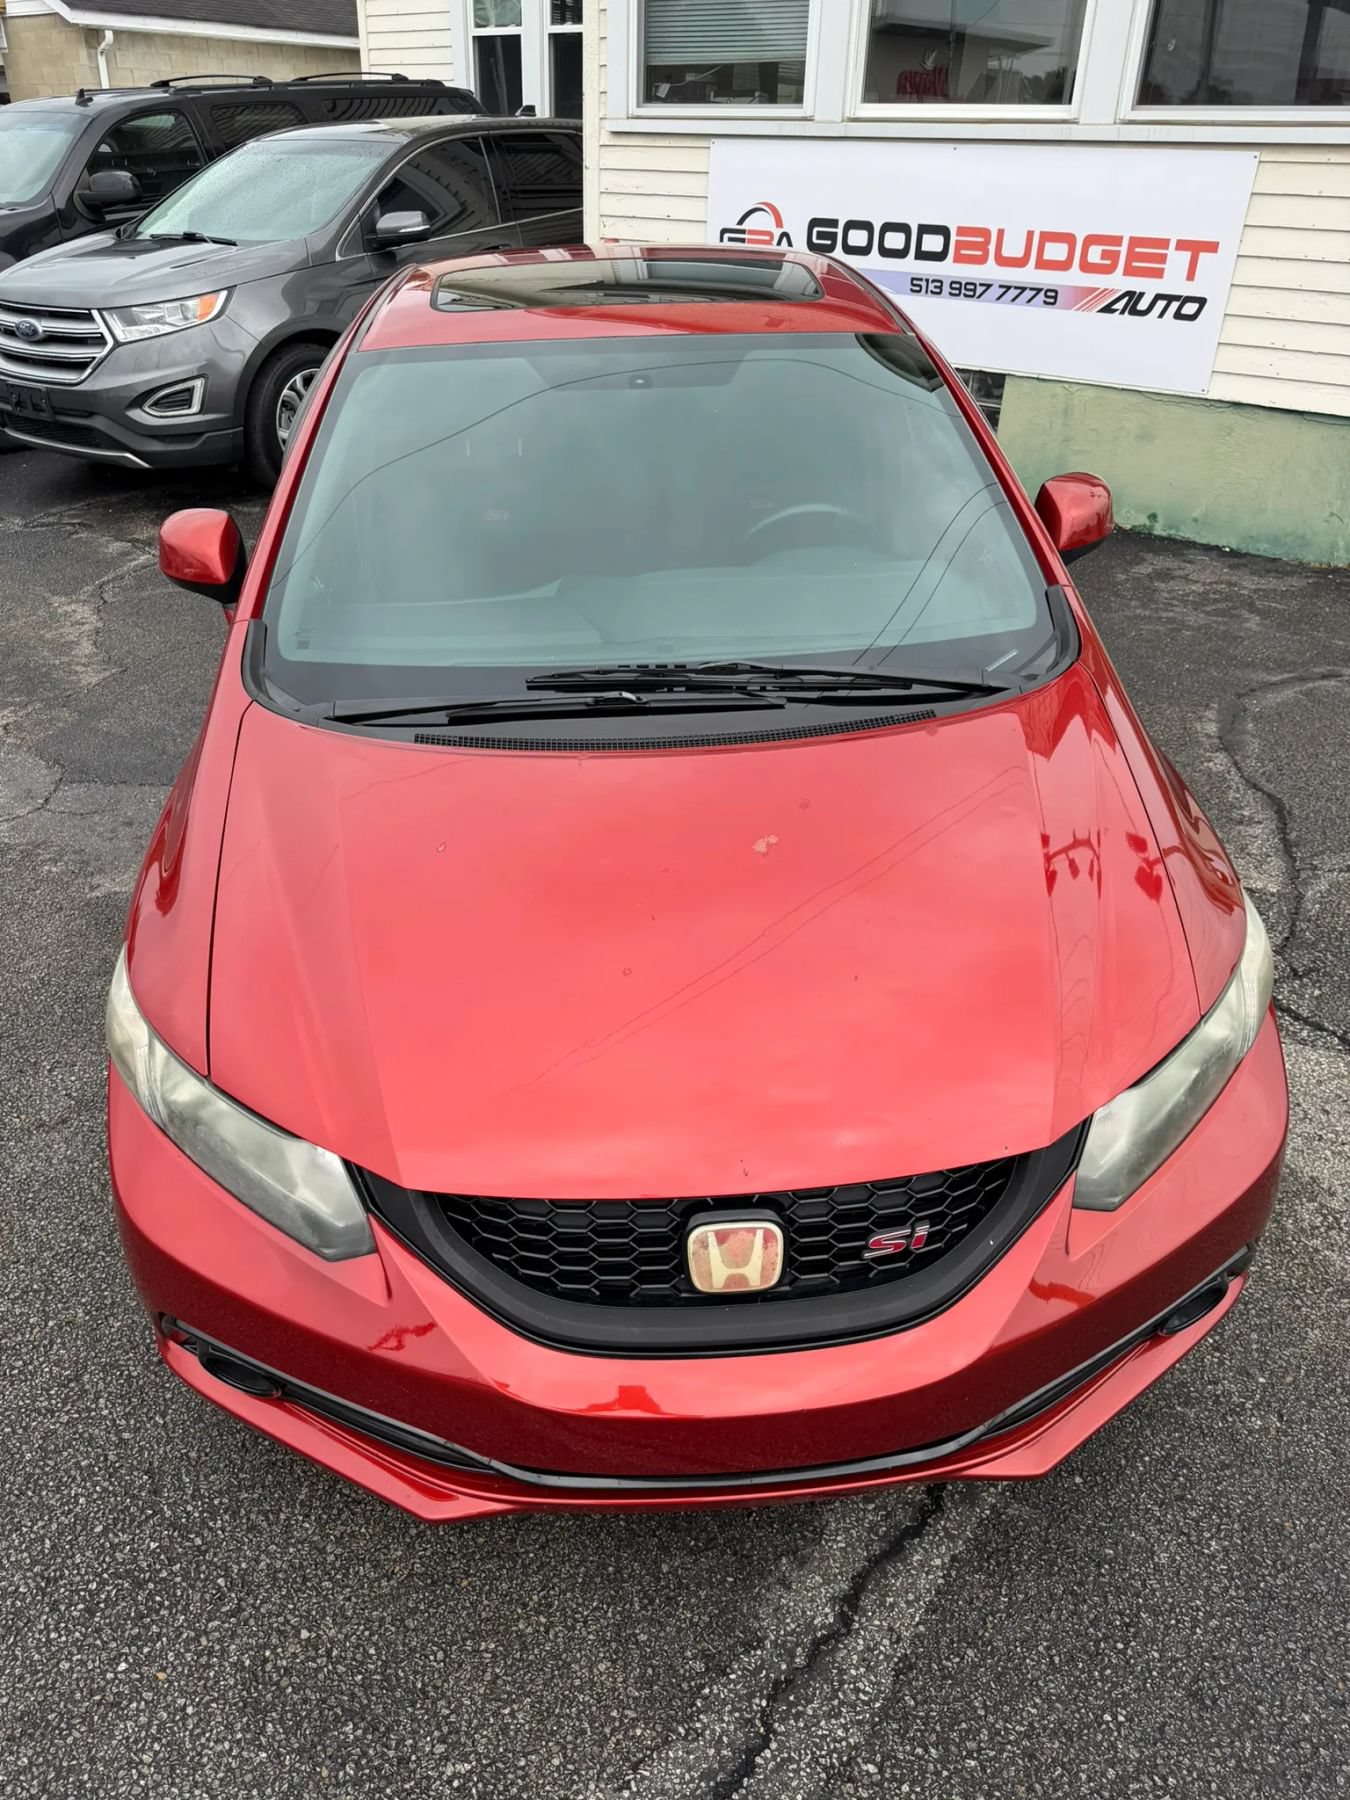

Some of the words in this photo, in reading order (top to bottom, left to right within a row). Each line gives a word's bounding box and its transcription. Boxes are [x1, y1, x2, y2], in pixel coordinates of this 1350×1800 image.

[909, 276, 943, 296] 513
[948, 280, 993, 300] 997
[995, 284, 1059, 306] 7779
[1096, 290, 1208, 322] AUTO
